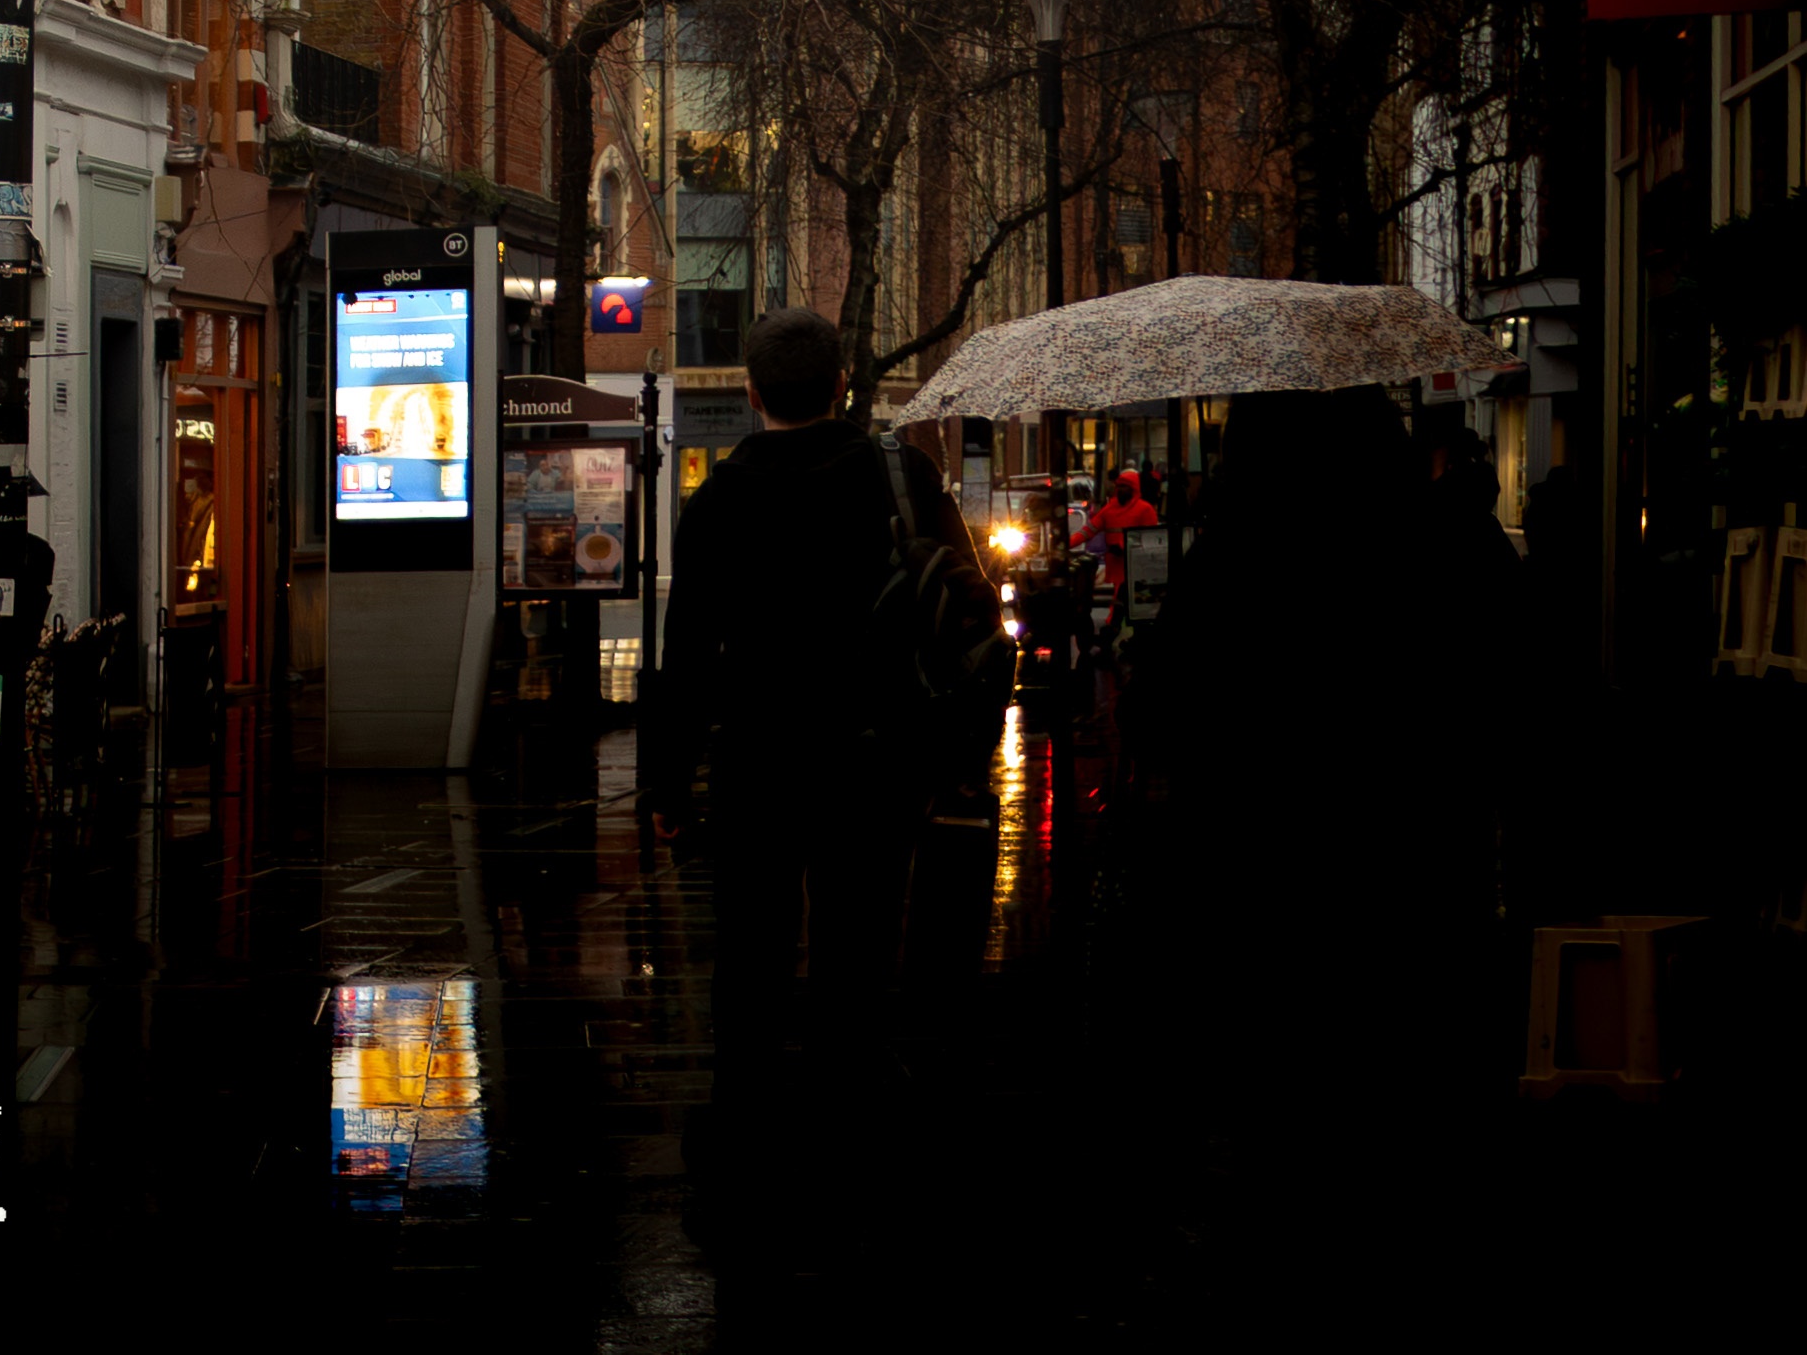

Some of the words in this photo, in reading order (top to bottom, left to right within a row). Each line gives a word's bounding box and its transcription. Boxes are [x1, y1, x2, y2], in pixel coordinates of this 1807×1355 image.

[448, 239, 463, 251] BT
[382, 268, 422, 287] global
[503, 398, 573, 416] chmond
